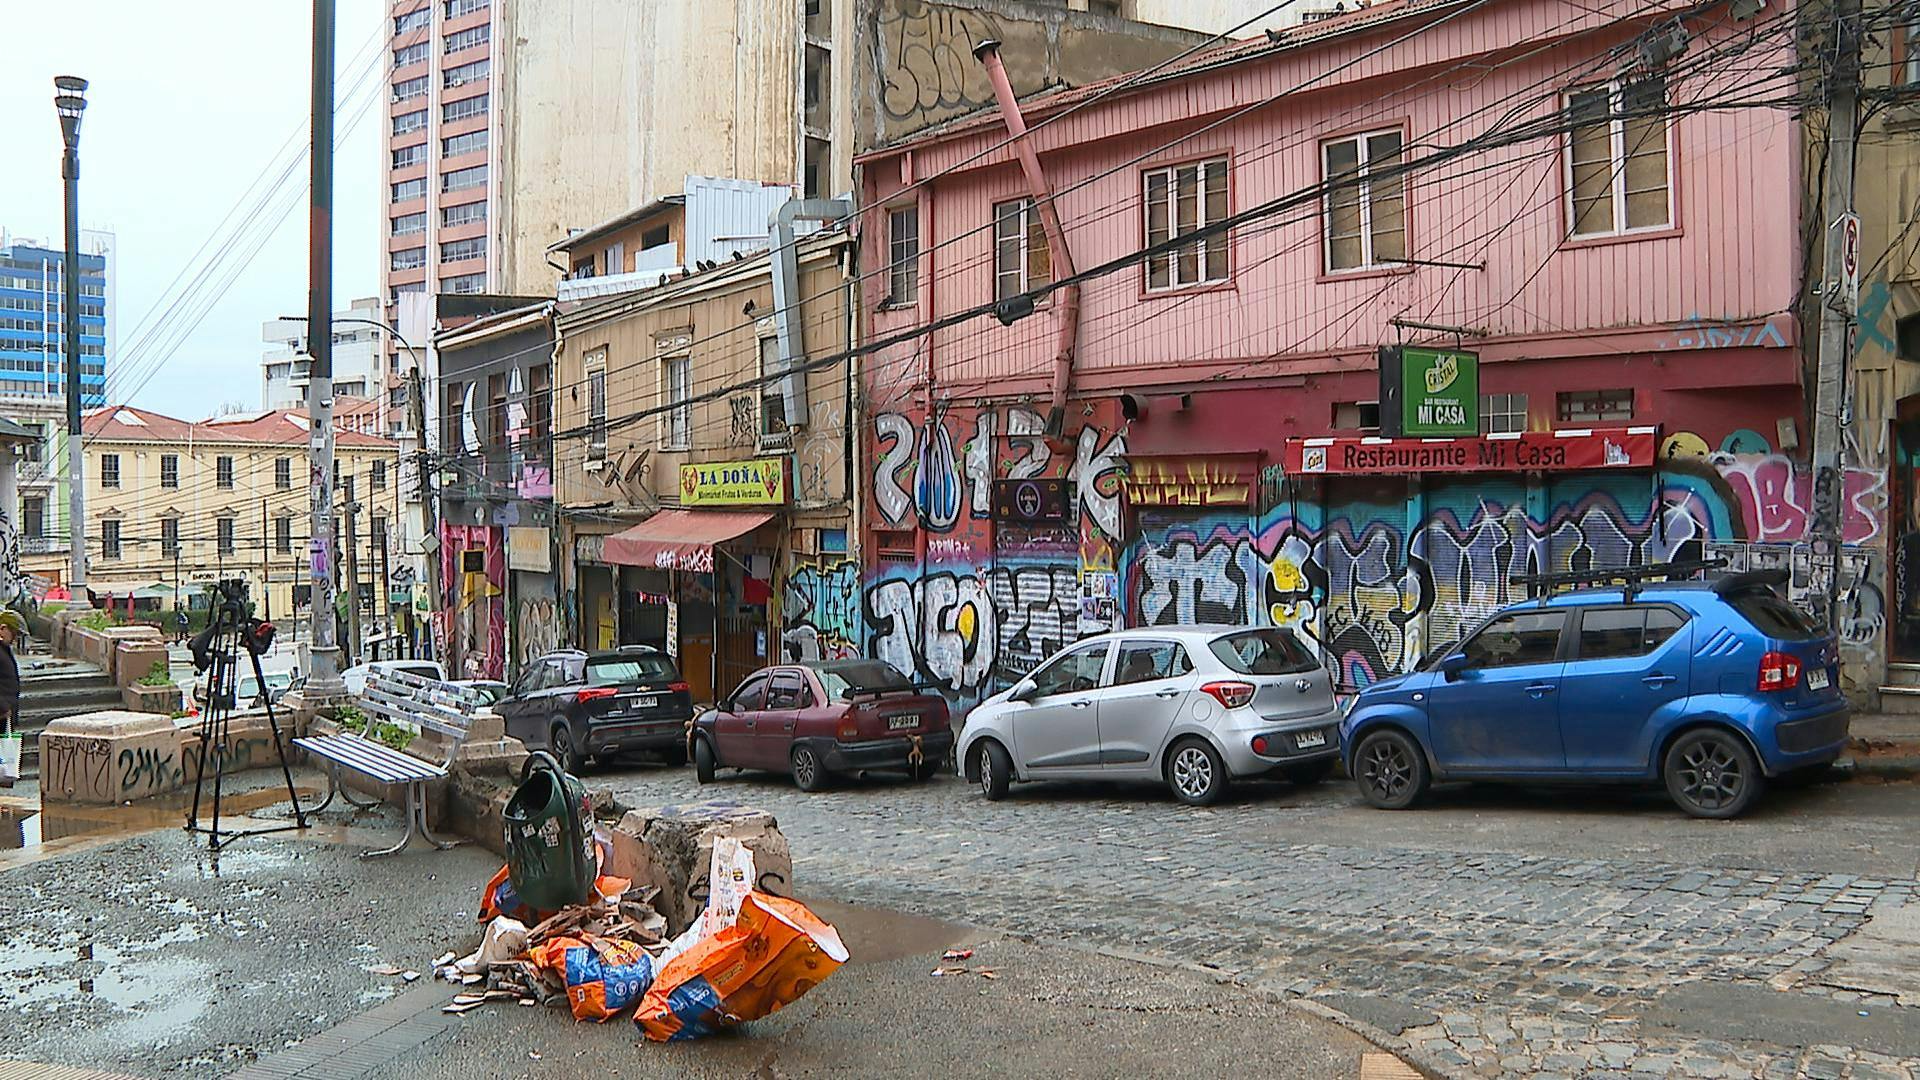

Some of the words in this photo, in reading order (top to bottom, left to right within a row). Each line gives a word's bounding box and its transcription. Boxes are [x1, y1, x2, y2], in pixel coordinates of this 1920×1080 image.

[1428, 362, 1456, 387] CRISTAL
[1418, 405, 1433, 424] MI
[1435, 406, 1466, 424] CASA
[1343, 446, 1466, 469] Restaurante
[1478, 442, 1505, 468] Mi
[1515, 440, 1566, 467] Casa
[699, 470, 718, 486] LA
[722, 465, 761, 485] DOÑA
